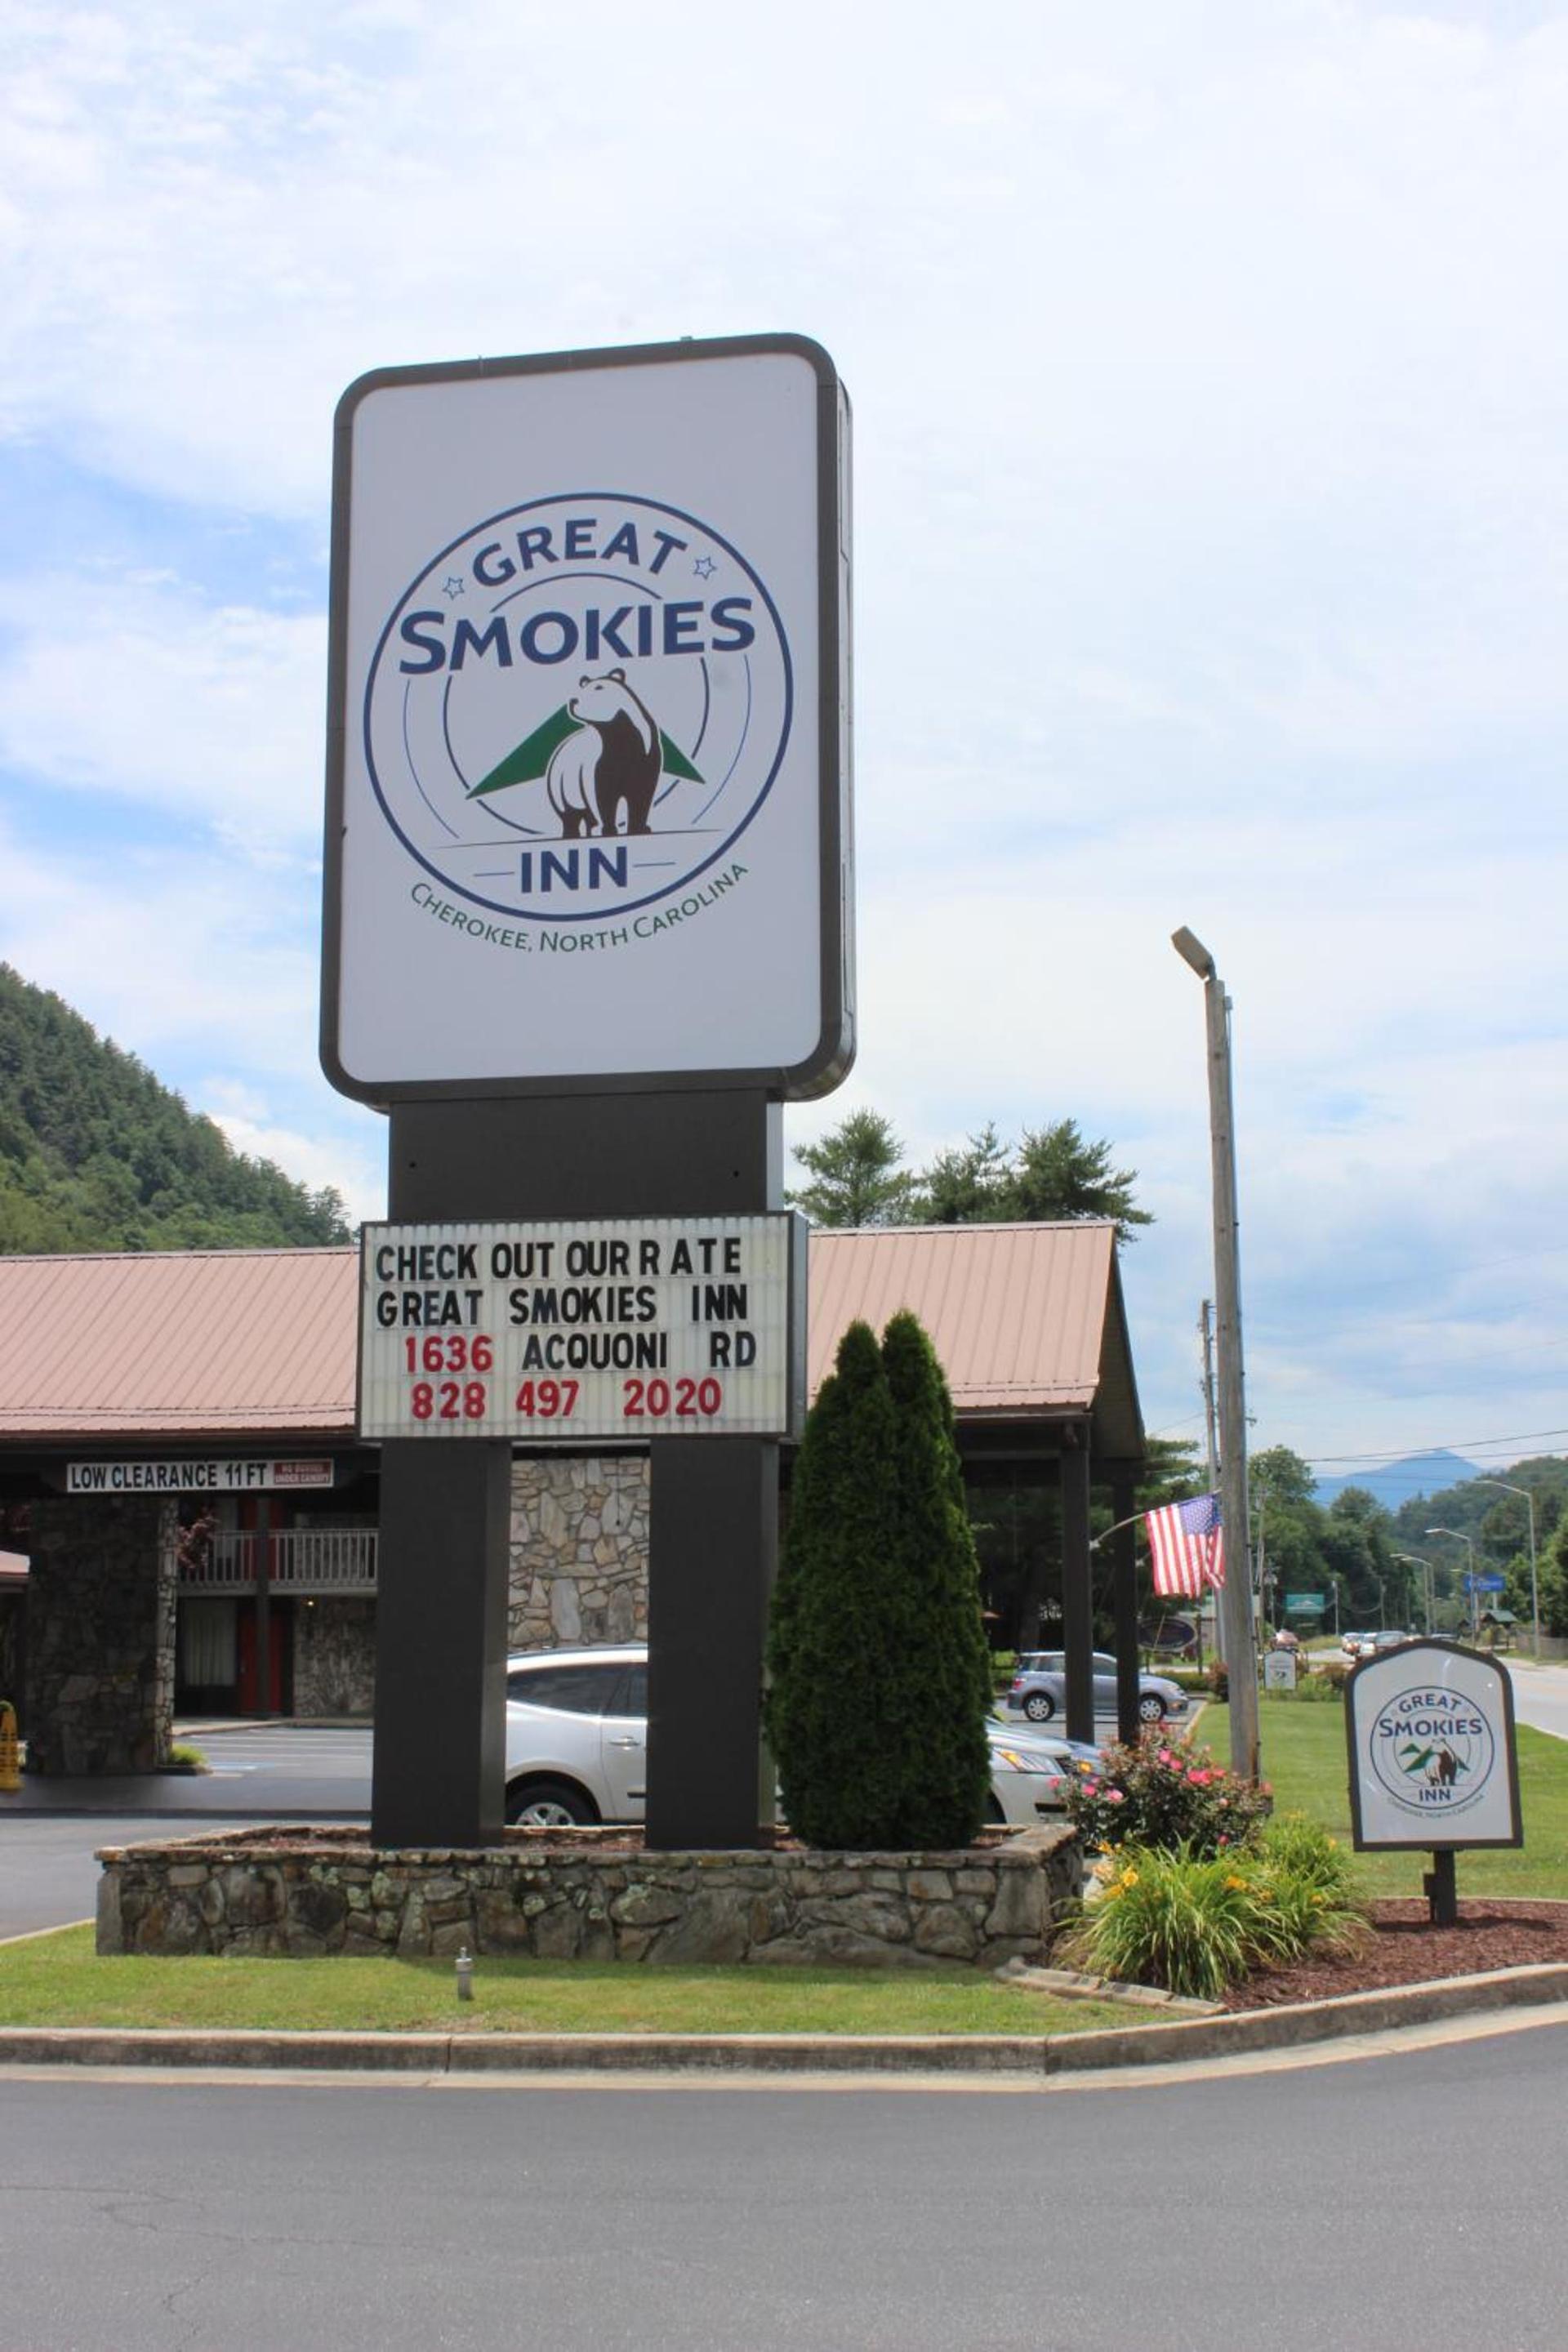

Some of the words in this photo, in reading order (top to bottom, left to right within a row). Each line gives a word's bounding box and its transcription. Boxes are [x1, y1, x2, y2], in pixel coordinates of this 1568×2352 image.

[472, 518, 688, 587] GREAT
[399, 598, 755, 675] SMOKIES
[520, 847, 627, 893] INN
[411, 883, 532, 953] CHEROKEE,
[540, 928, 628, 953] NORTH
[633, 863, 749, 940] CAROLINA
[376, 1244, 478, 1281] CHECK
[492, 1242, 555, 1278] OUT
[567, 1240, 630, 1276] OUR
[640, 1237, 742, 1275] RATE
[377, 1290, 483, 1327] GREAT
[510, 1286, 656, 1325] SMOKIES
[692, 1284, 747, 1321] INN
[406, 1335, 493, 1374] 1636
[522, 1333, 667, 1370] ACQUONI
[710, 1331, 757, 1368] RD
[412, 1382, 486, 1419] 828
[515, 1379, 580, 1417] 497
[624, 1378, 722, 1415] 2020
[71, 1467, 107, 1489] LOW
[111, 1463, 217, 1488] CLEARANCE
[225, 1463, 243, 1486] 11
[247, 1463, 267, 1485] FT
[1399, 1694, 1461, 1713] GREAT
[1379, 1718, 1483, 1737] SMOKIES
[1419, 1788, 1451, 1802] INN
